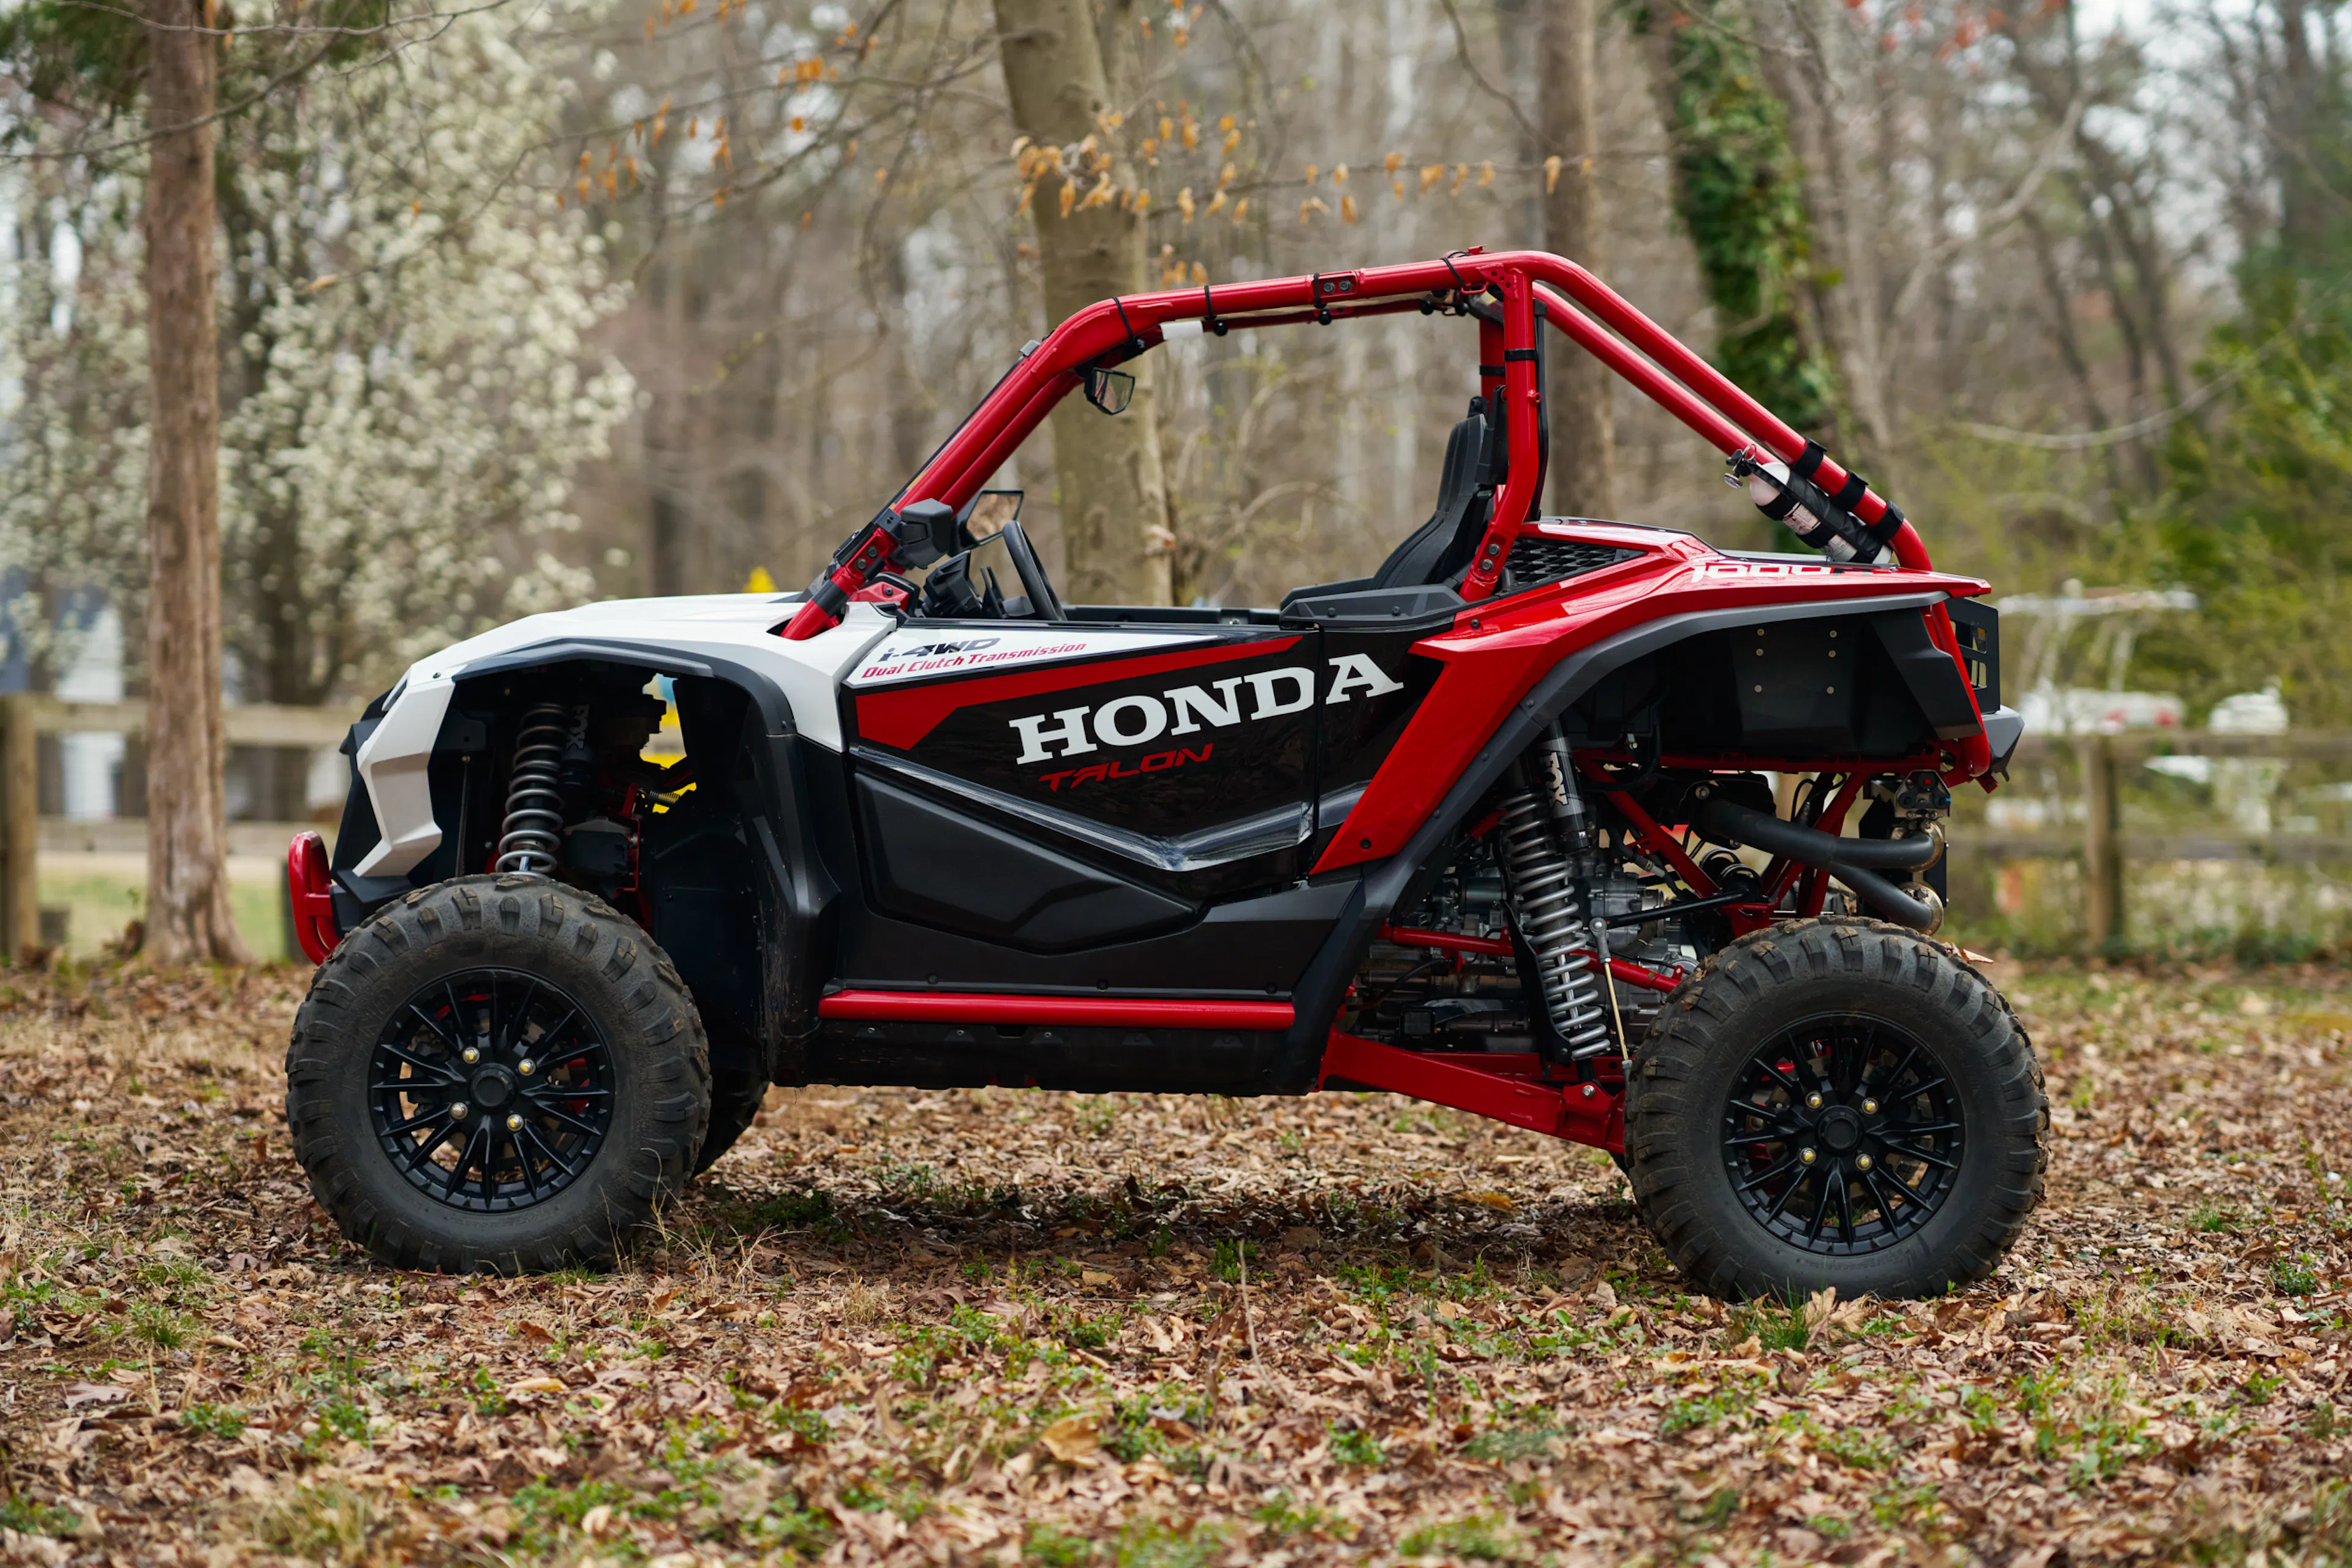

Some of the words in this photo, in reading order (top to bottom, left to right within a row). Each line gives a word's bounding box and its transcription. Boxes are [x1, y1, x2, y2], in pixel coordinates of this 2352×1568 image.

[861, 663, 903, 679] Dual
[907, 655, 964, 673] Clutch
[968, 643, 1087, 665] Transmission
[877, 638, 1001, 663] i-4WD
[565, 703, 590, 749] FOX
[1008, 653, 1404, 766] HONDA
[1039, 743, 1214, 793] TALON
[1540, 751, 1569, 808] FOX
